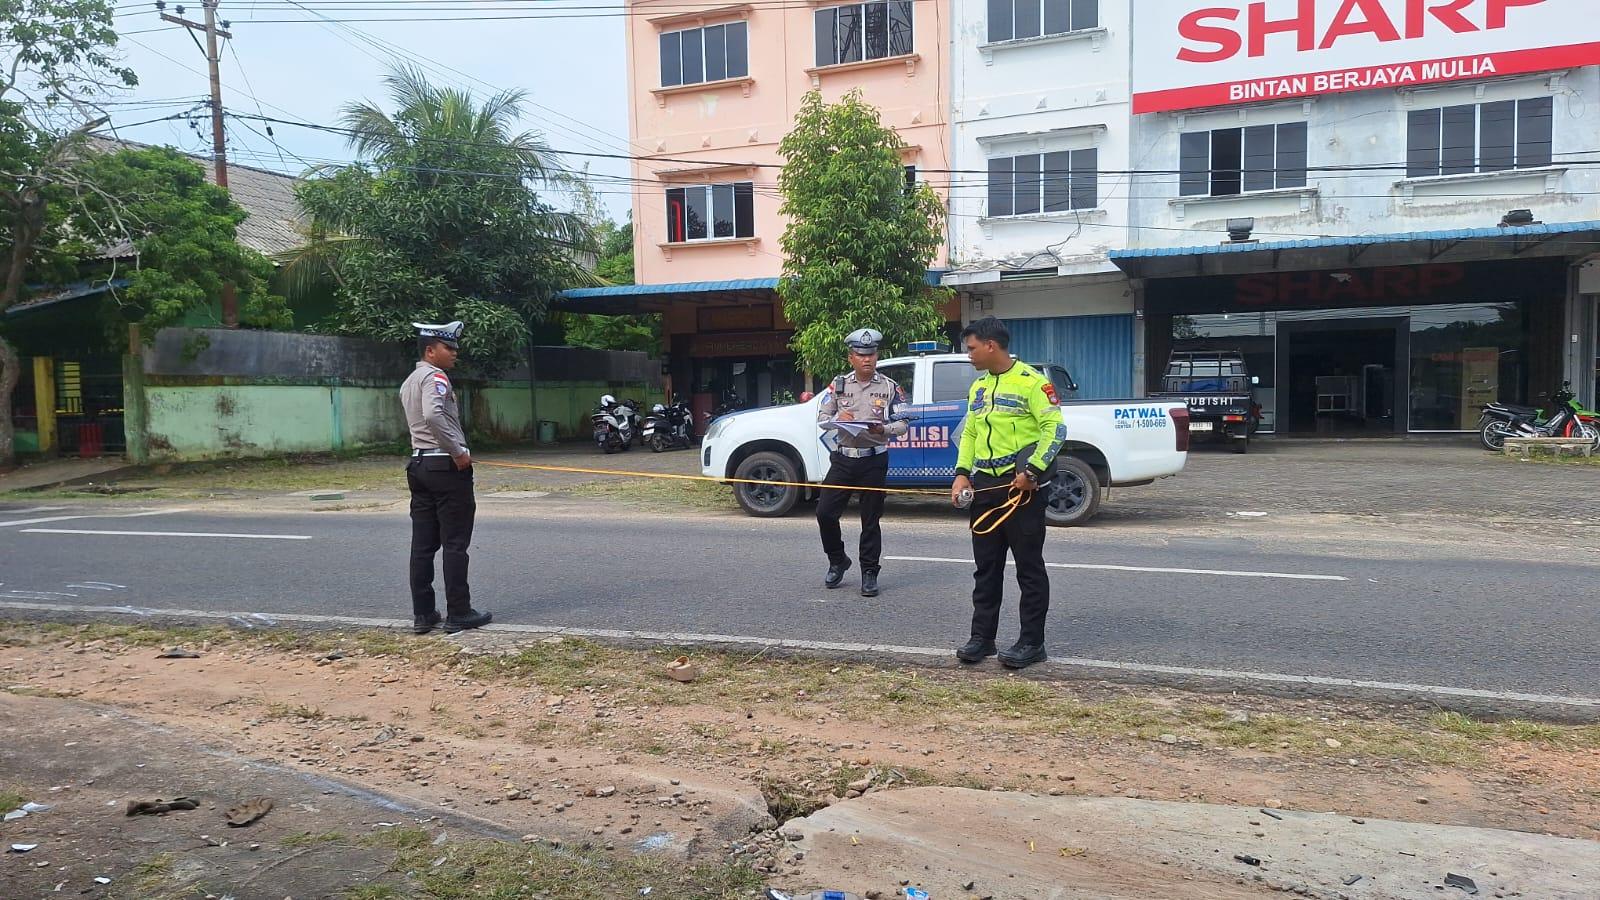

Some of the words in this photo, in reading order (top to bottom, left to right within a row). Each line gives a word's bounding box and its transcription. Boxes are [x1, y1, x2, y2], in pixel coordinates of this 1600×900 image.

[1229, 77, 1307, 101] BINTAN
[1313, 65, 1416, 91] BERJAYA
[1421, 56, 1496, 80] MULIA
[1235, 264, 1466, 305] SHARP
[1114, 408, 1166, 419] PATWAL
[1137, 419, 1166, 428] 1-500-669
[888, 426, 949, 441] OLISI
